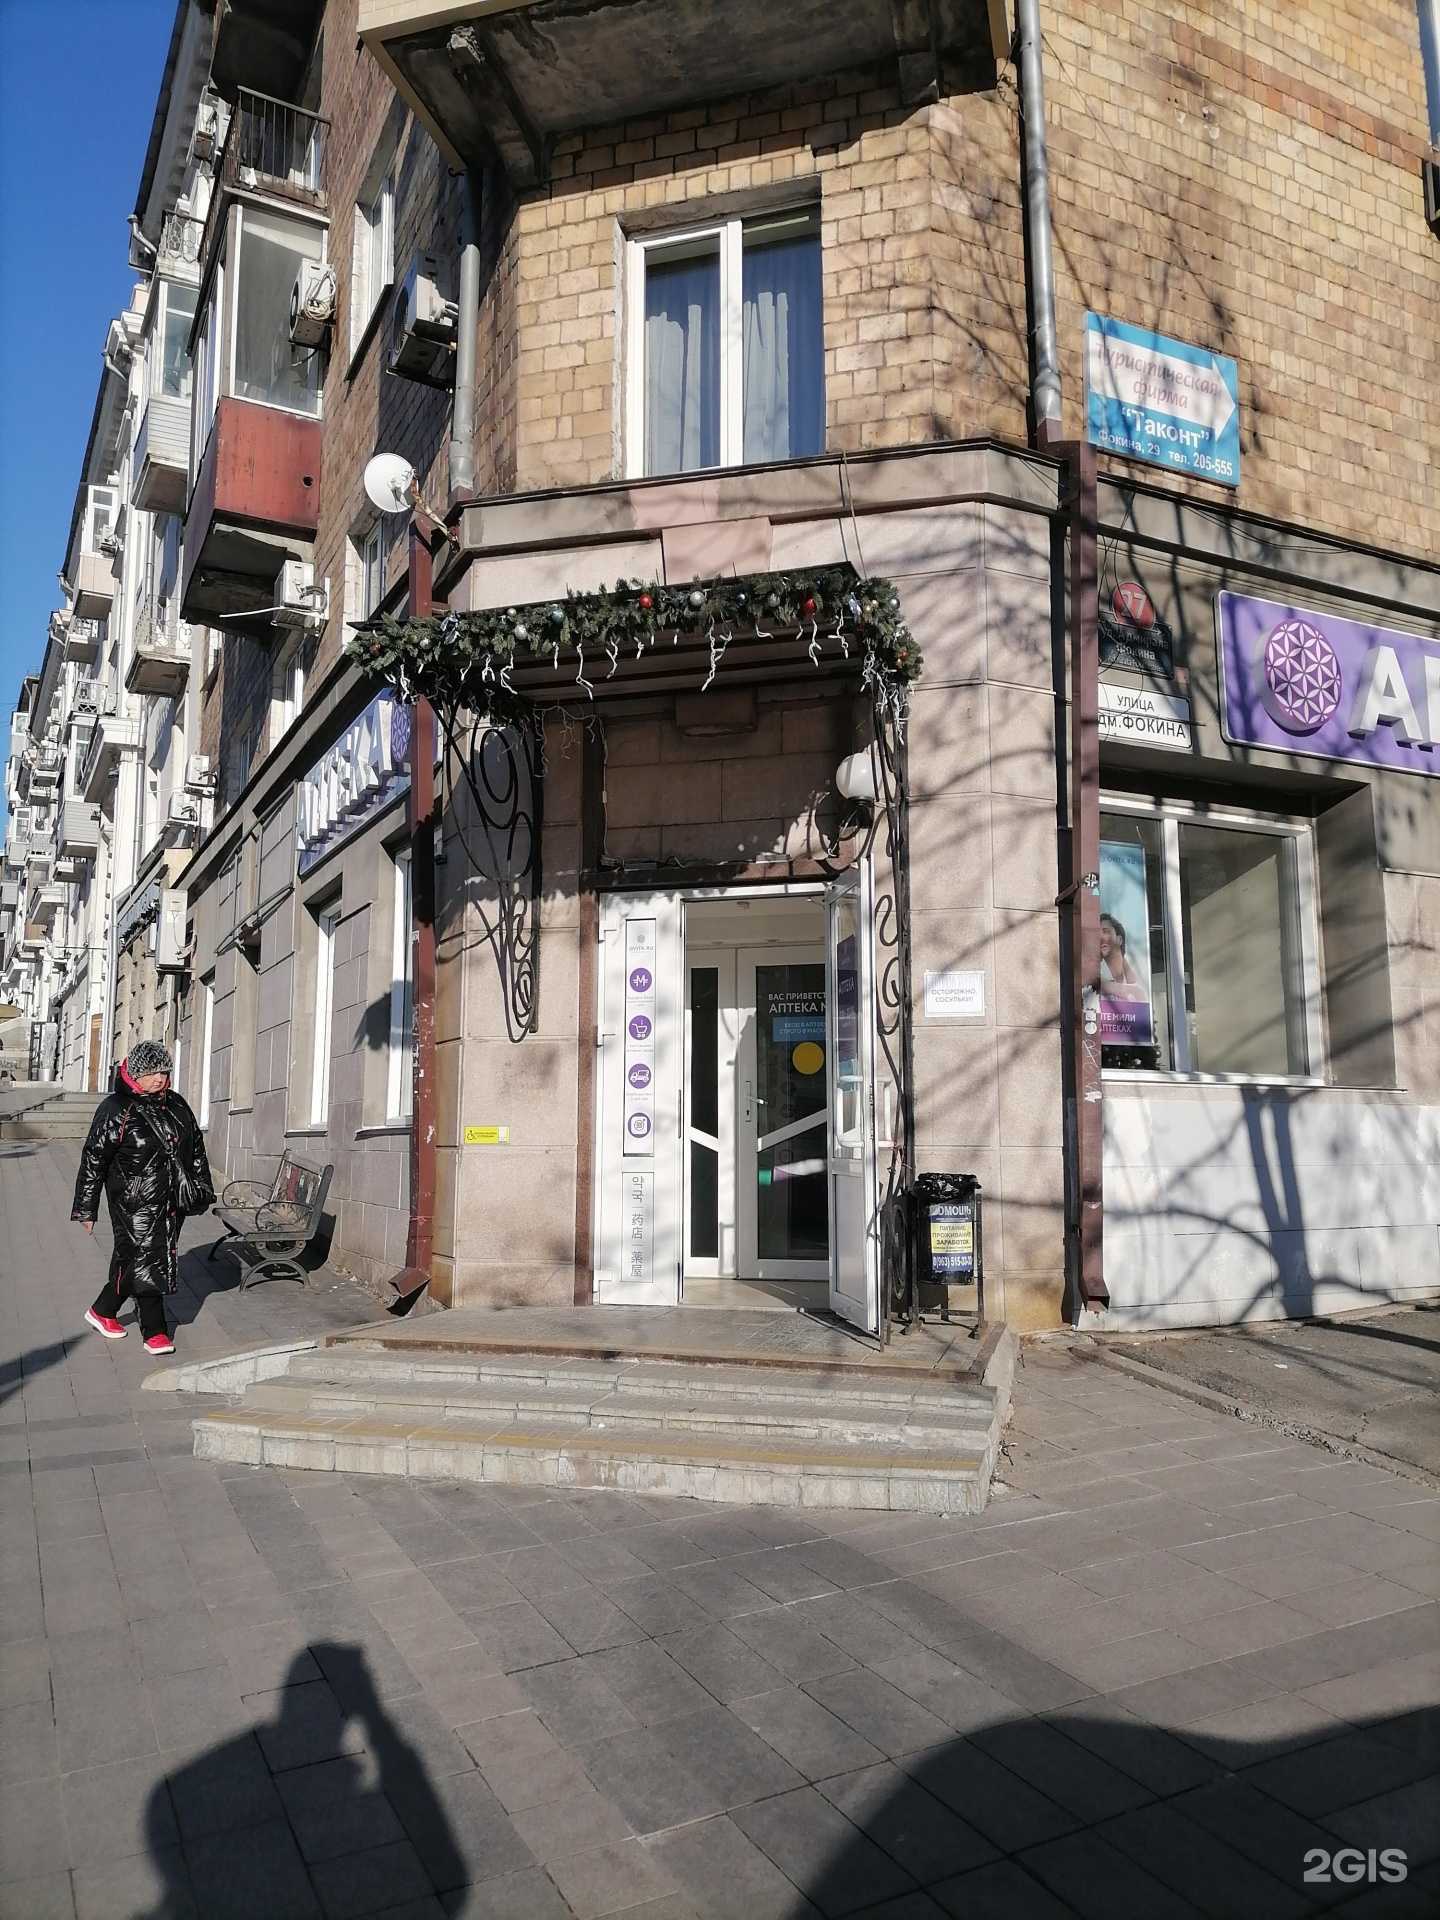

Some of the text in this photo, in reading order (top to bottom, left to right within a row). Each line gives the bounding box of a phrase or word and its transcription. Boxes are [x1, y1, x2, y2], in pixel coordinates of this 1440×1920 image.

[1133, 379, 1189, 409] фирма
[1147, 442, 1161, 456] 29
[1168, 450, 1190, 465] тел.
[1193, 452, 1234, 477] 205-555
[1117, 694, 1155, 713] УЛИЦА
[768, 993, 785, 1001] ВАС
[769, 1002, 818, 1014] АПТЕКА
